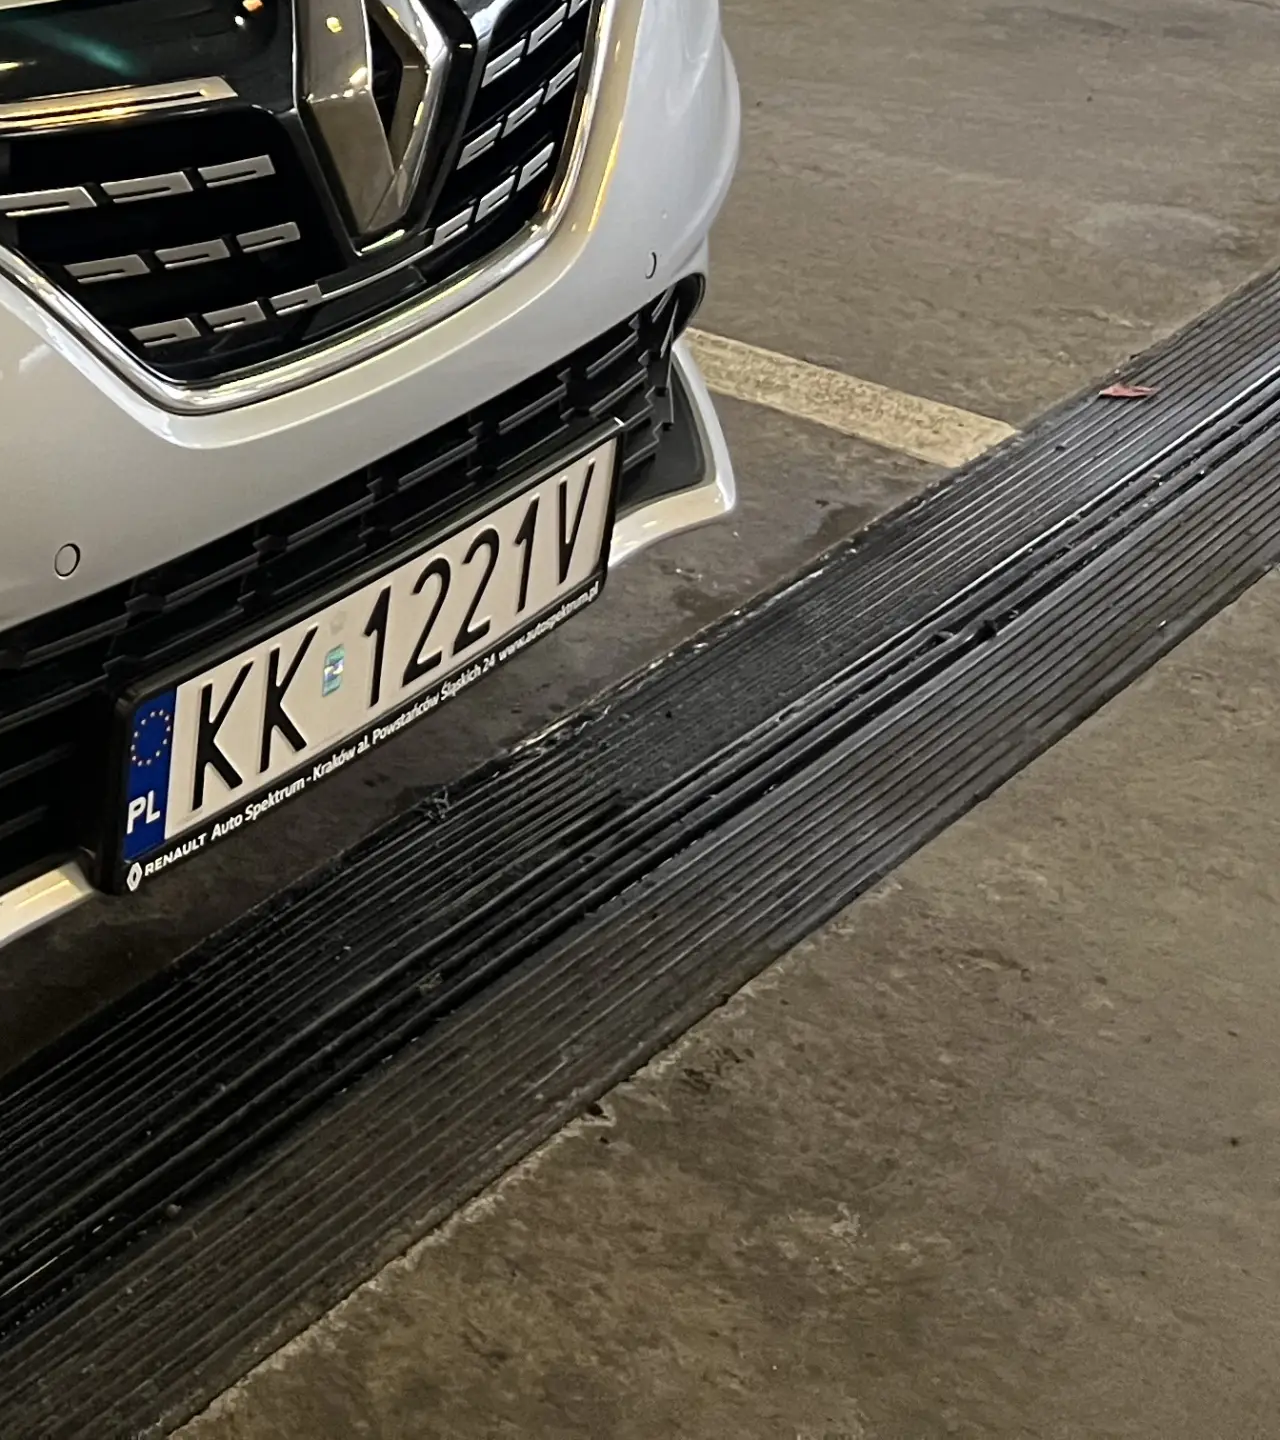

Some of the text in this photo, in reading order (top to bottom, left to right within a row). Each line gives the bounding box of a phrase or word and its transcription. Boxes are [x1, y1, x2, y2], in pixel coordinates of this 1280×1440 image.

[144, 832, 208, 877] RENAULT
[210, 812, 243, 841] Auto
[244, 777, 305, 821] Spektrum
[312, 745, 357, 781] Kraków
[357, 734, 371, 754] al.
[372, 692, 440, 745] Powstańców
[440, 663, 482, 701] Śląskich
[482, 652, 496, 673] 24
[498, 580, 600, 662] www.autospektrum.pl
[191, 456, 596, 812] KK 1221V
[126, 790, 161, 835] PL
